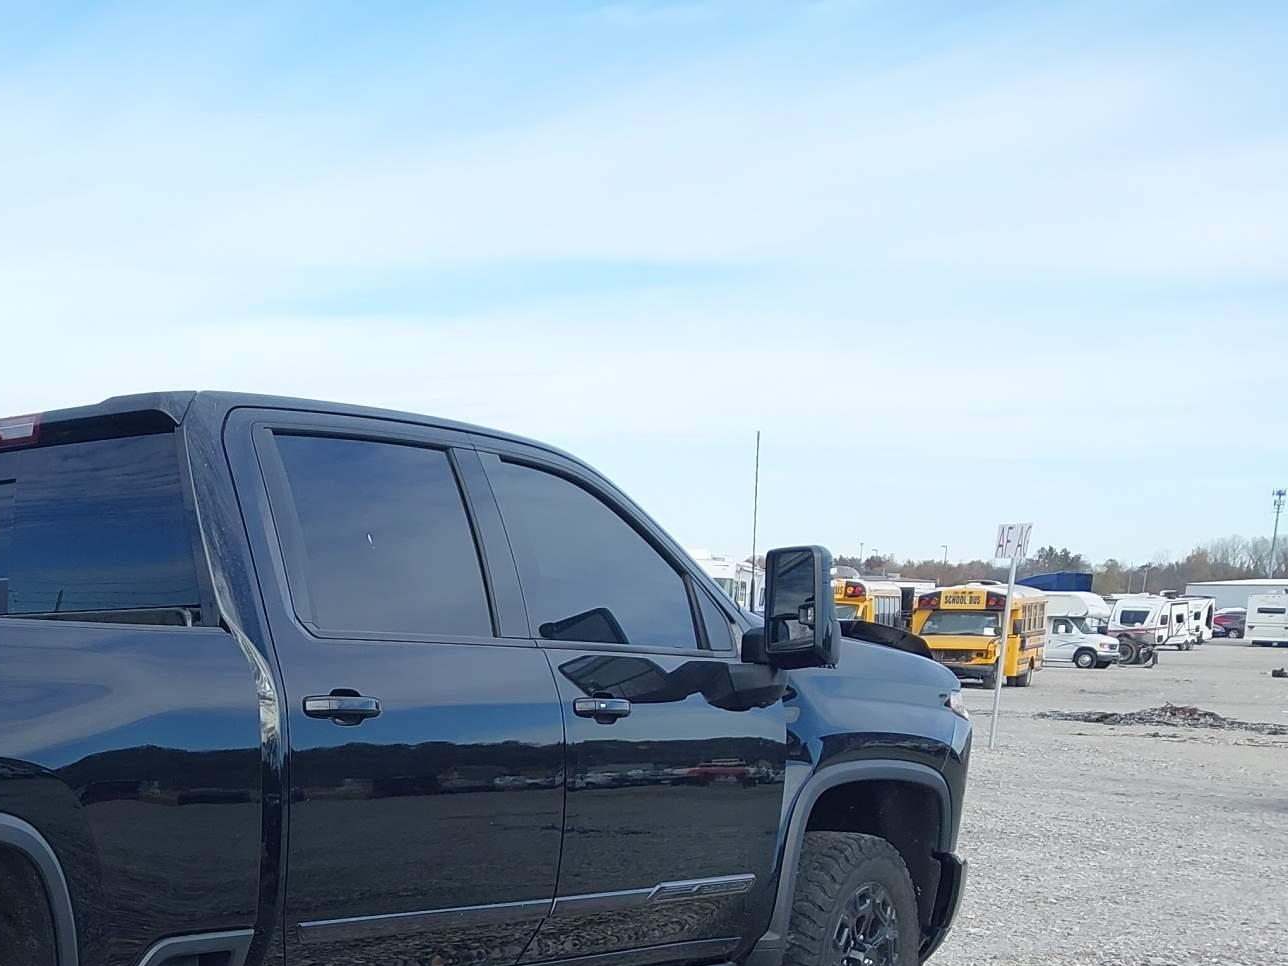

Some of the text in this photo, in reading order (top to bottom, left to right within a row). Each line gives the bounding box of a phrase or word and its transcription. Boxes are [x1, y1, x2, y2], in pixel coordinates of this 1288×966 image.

[995, 526, 1013, 558] AF
[944, 595, 981, 605] SCHOOL BUS
